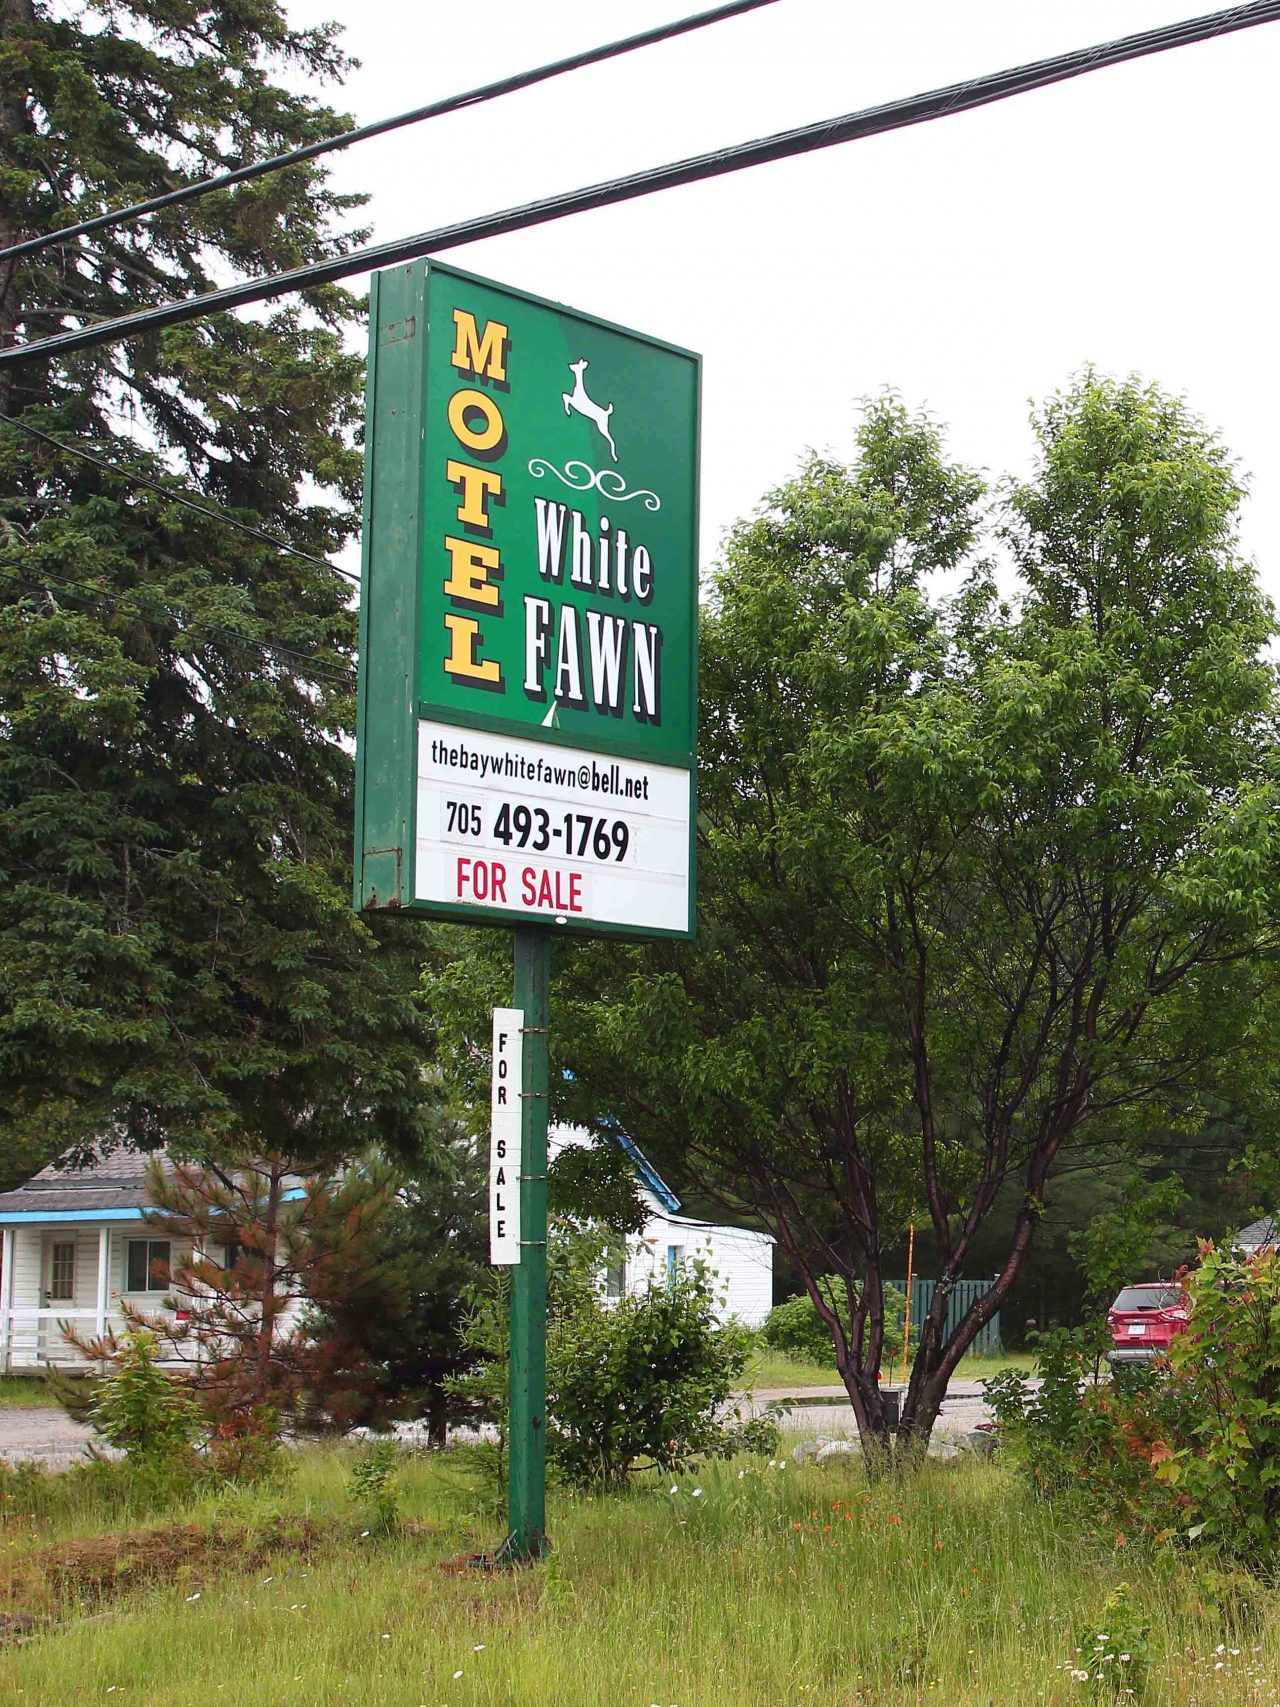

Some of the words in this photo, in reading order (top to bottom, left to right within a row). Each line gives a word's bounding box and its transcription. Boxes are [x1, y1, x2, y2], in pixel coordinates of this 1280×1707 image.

[444, 308, 510, 691] MOTEL
[534, 496, 653, 599] White
[523, 596, 661, 719] FAWN
[431, 740, 649, 801] thebaywhitefawn@bell.net
[446, 801, 482, 837] 705
[493, 803, 630, 862] 493-1769
[456, 857, 507, 903] FOR
[521, 867, 583, 913] SALE
[498, 1033, 508, 1105] FOR
[496, 1139, 507, 1238] SALE
